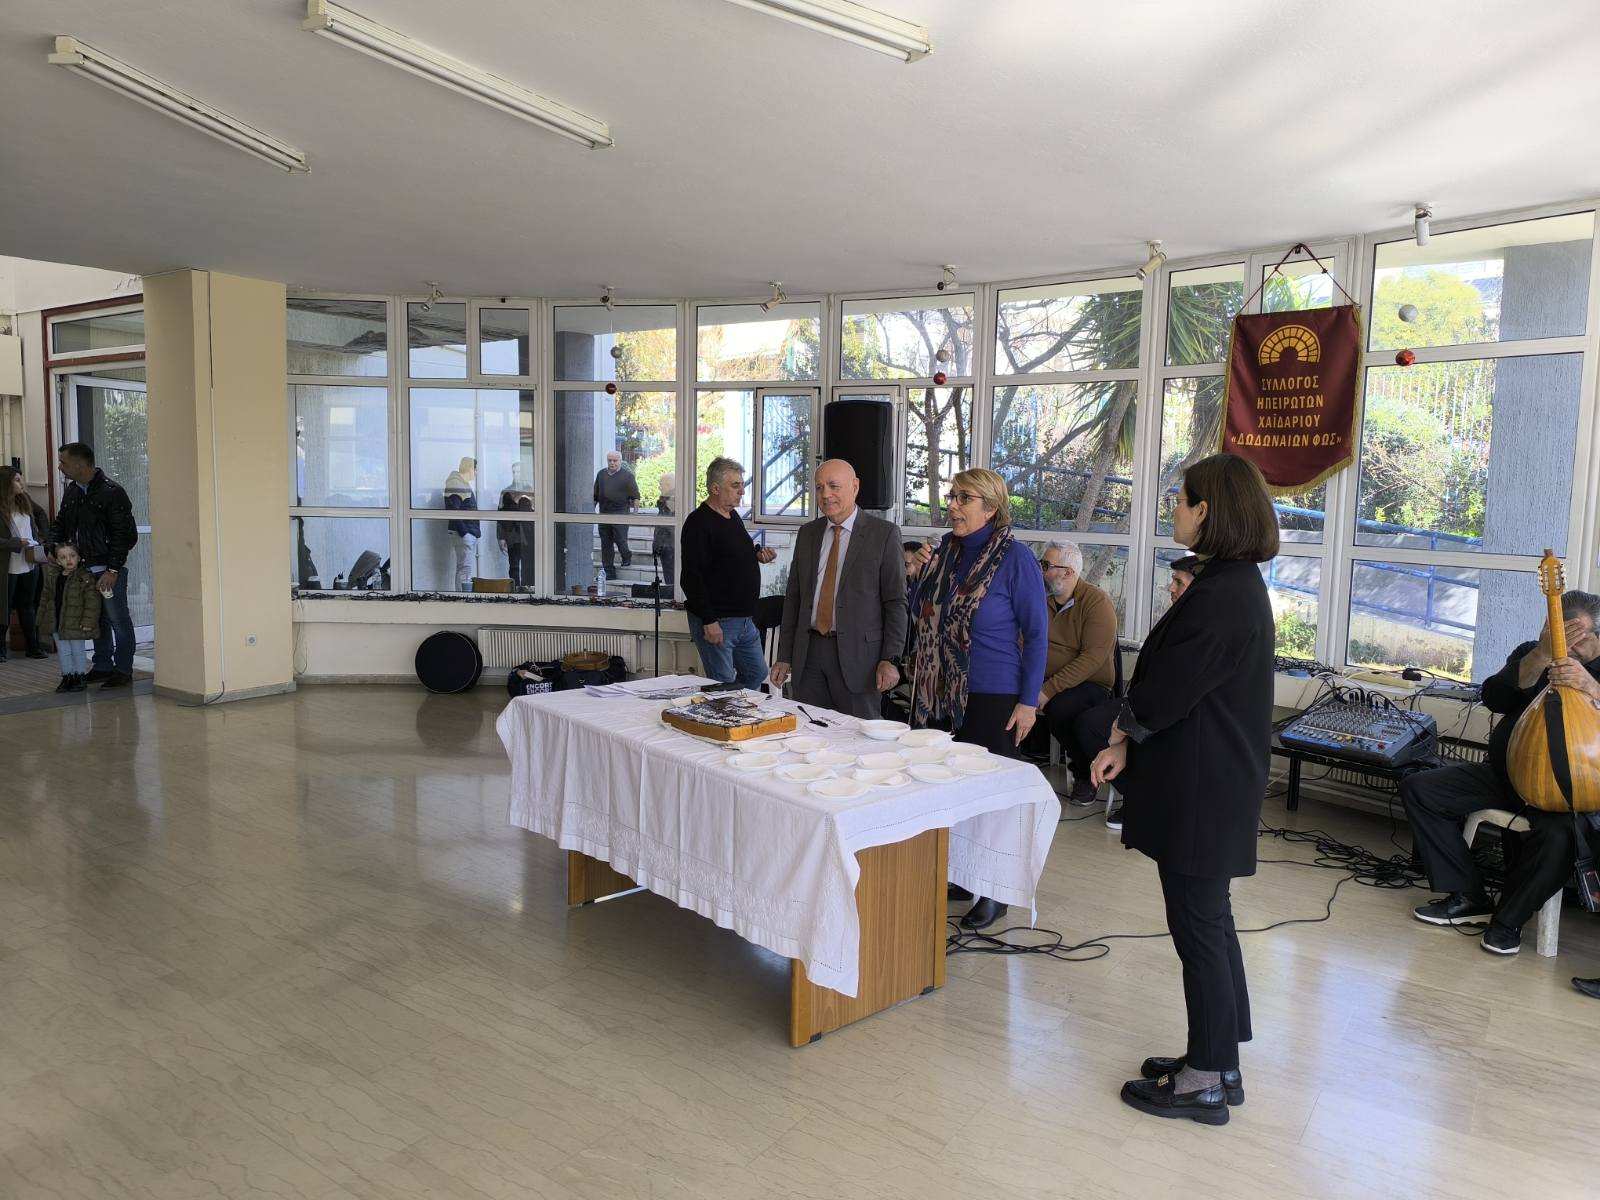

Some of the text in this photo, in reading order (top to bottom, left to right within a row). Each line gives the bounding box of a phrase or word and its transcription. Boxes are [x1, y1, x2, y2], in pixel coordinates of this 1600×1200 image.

[1261, 376, 1319, 390] ΣΥΛΛΟΓΟΣ
[1257, 394, 1324, 410] ΗΠΕΙΡΩΤΩΝ
[1258, 414, 1321, 428] ΧΑΪΔΑΡΙΟΥ
[1231, 433, 1342, 447] «ΔΩΔΩΝΑΙΩΝ ΦΩΣ»
